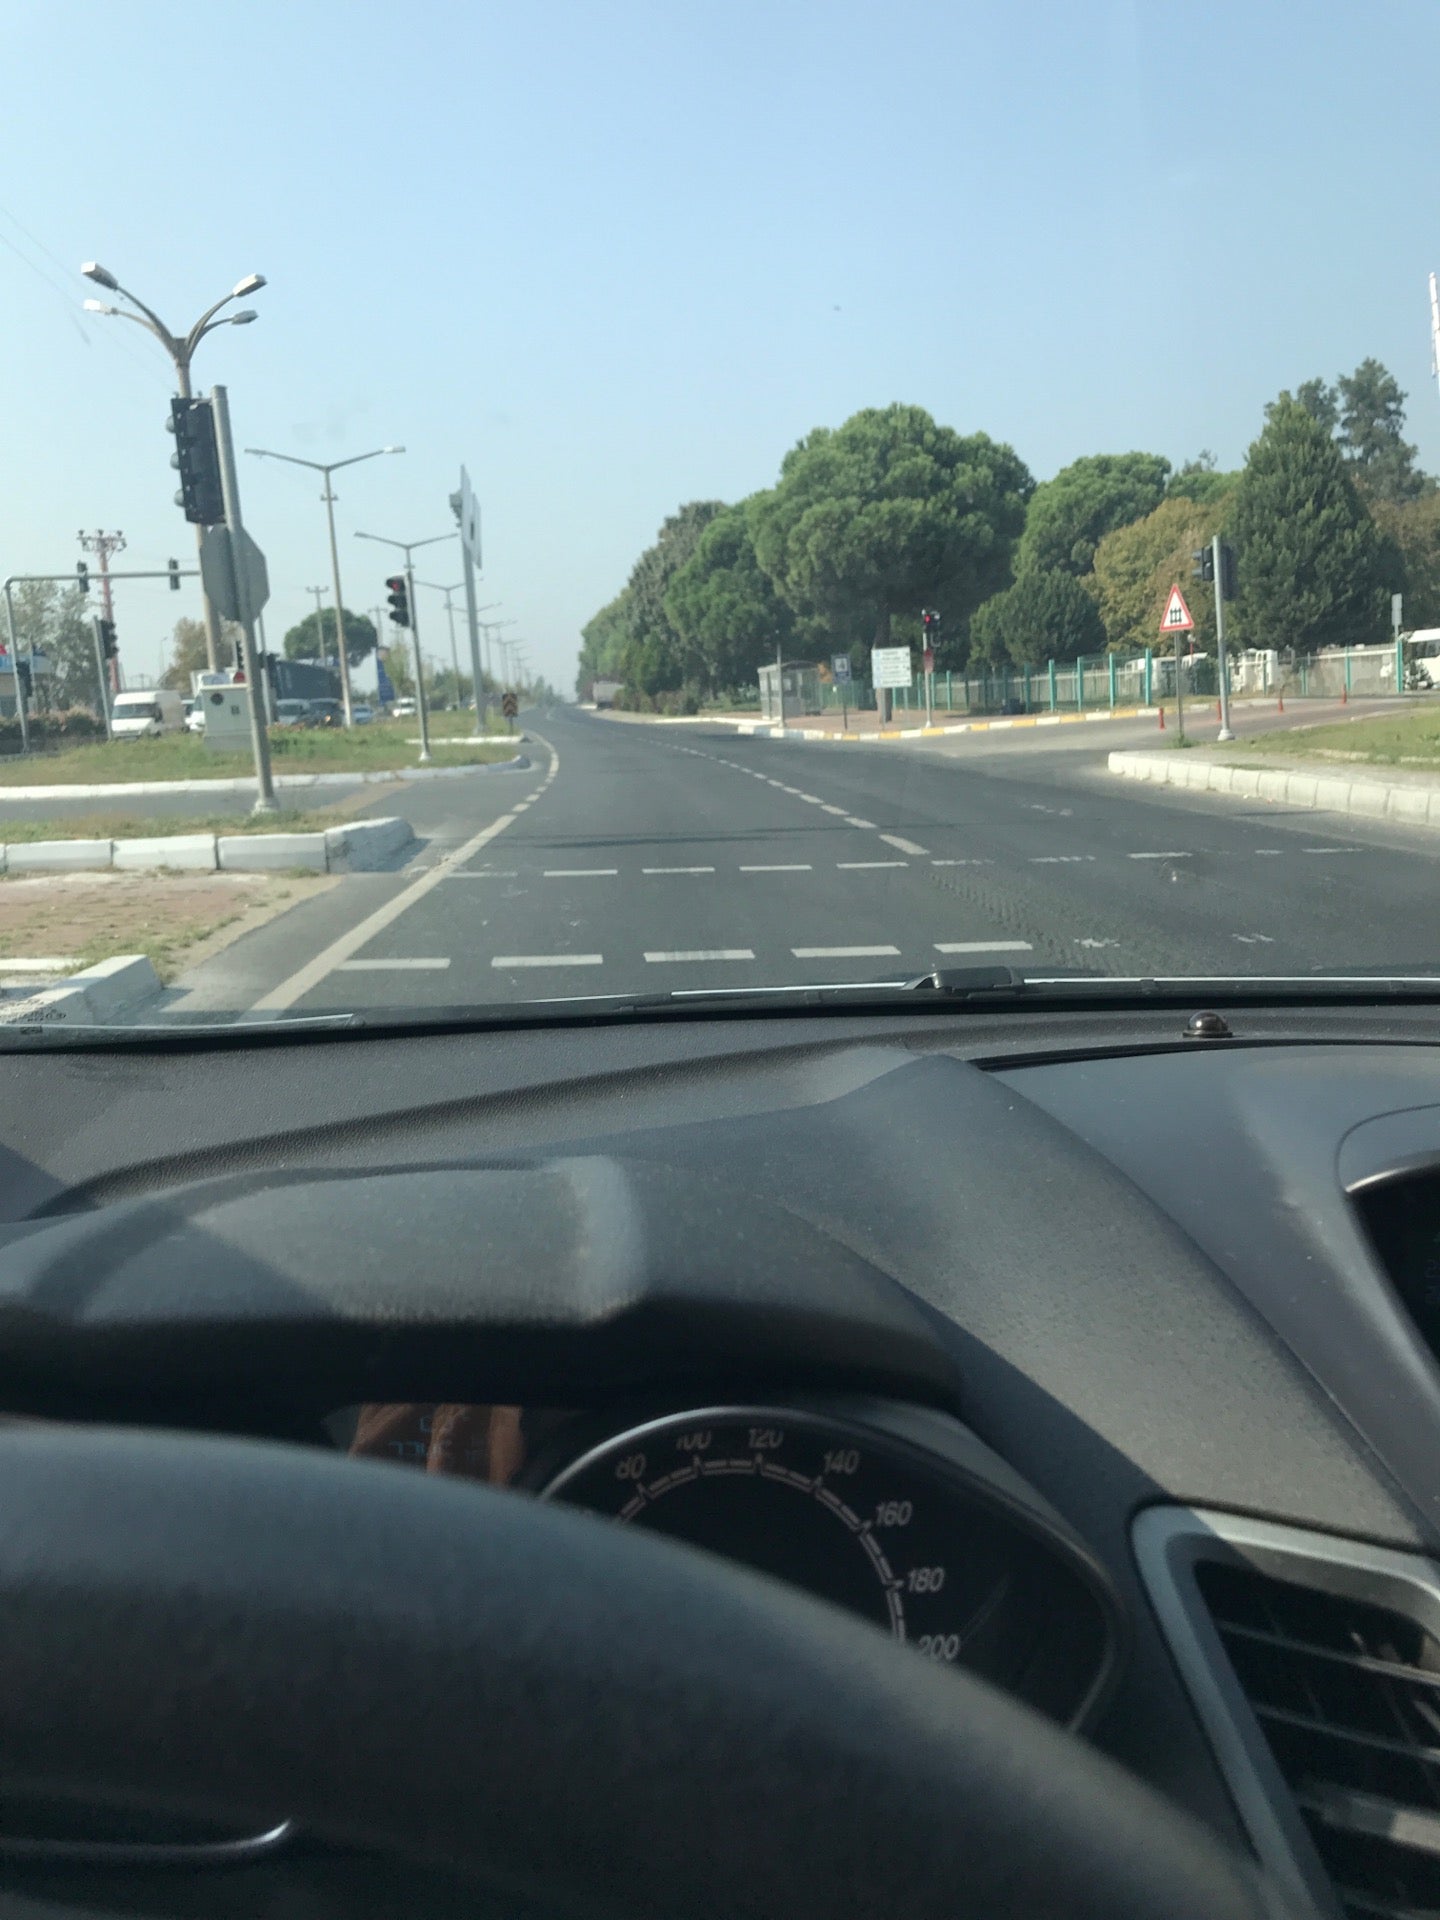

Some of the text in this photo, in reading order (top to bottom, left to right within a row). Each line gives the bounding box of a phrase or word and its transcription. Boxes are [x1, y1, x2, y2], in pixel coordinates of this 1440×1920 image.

[750, 1428, 784, 1449] 120
[824, 1450, 860, 1475] 140
[876, 1501, 913, 1526] 160
[908, 1566, 946, 1592] 180
[918, 1634, 960, 1660] 200
